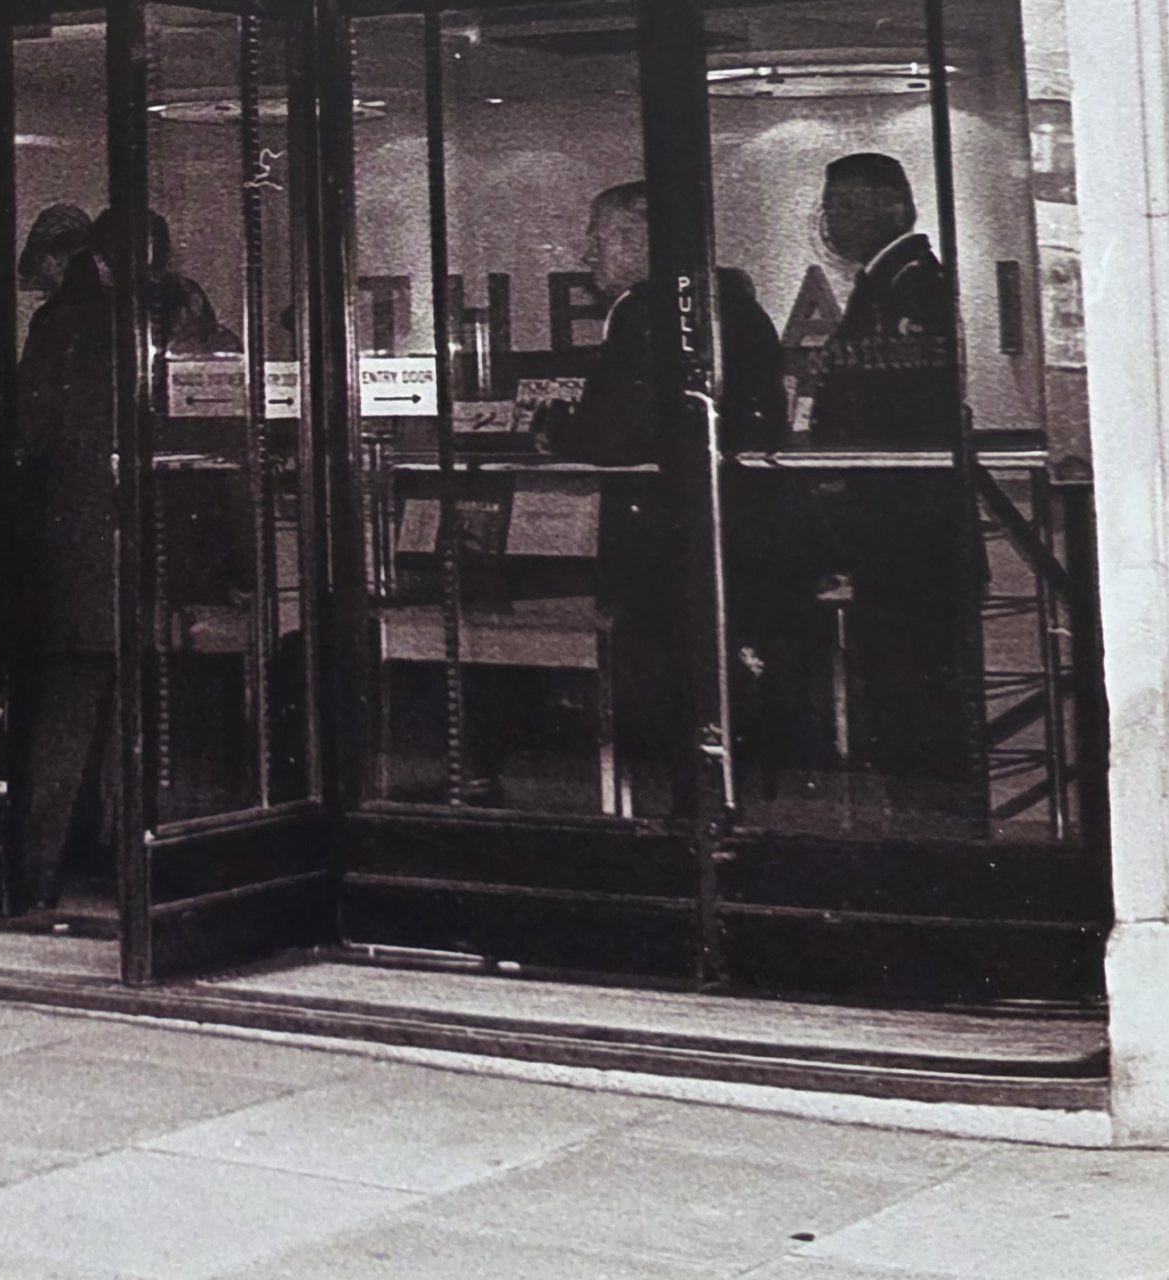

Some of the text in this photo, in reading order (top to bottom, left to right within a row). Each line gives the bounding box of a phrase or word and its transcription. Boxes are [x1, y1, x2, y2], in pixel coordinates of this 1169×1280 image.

[678, 276, 694, 352] PULL
[362, 370, 433, 384] ENTRY DOOR
